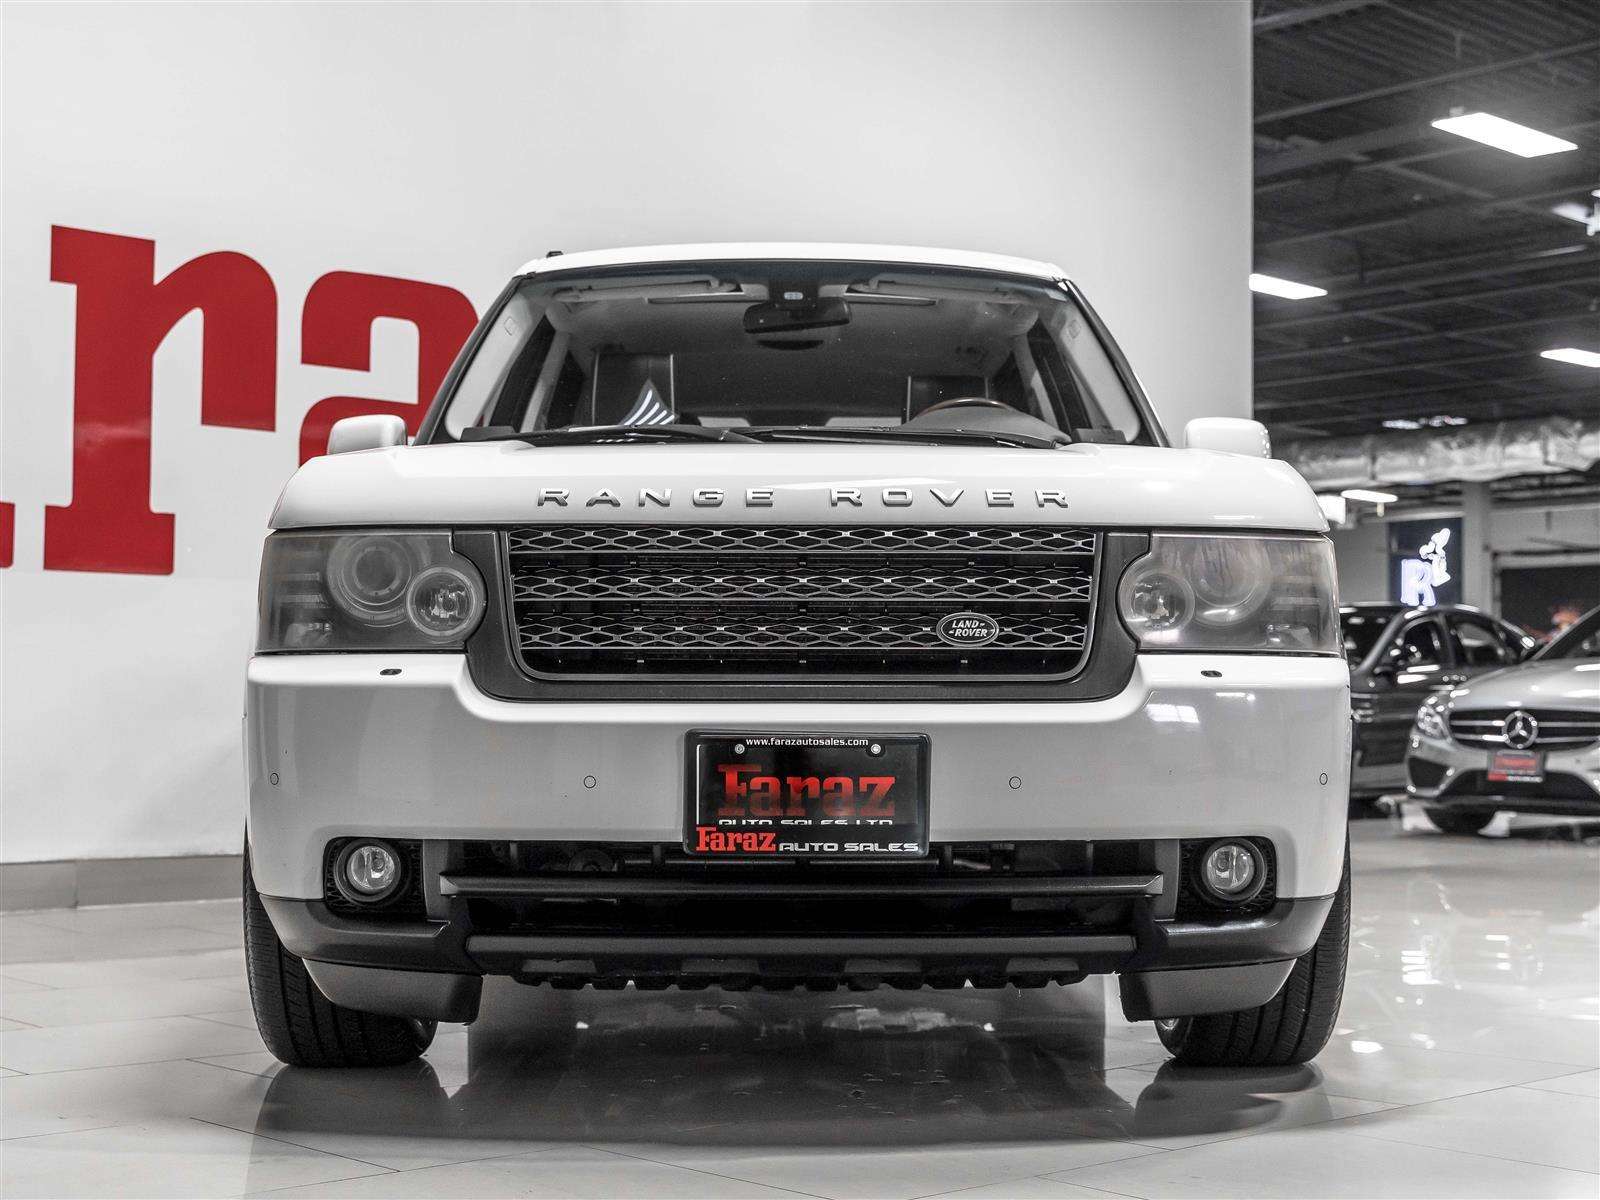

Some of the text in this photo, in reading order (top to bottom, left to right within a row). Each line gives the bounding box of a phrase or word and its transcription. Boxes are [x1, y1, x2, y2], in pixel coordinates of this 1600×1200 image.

[537, 487, 1071, 508] RANGE ROVER
[746, 737, 869, 746] www.farazautosales.com
[717, 764, 896, 817] Faraz
[696, 826, 919, 853] Faraz AUTO SALES
